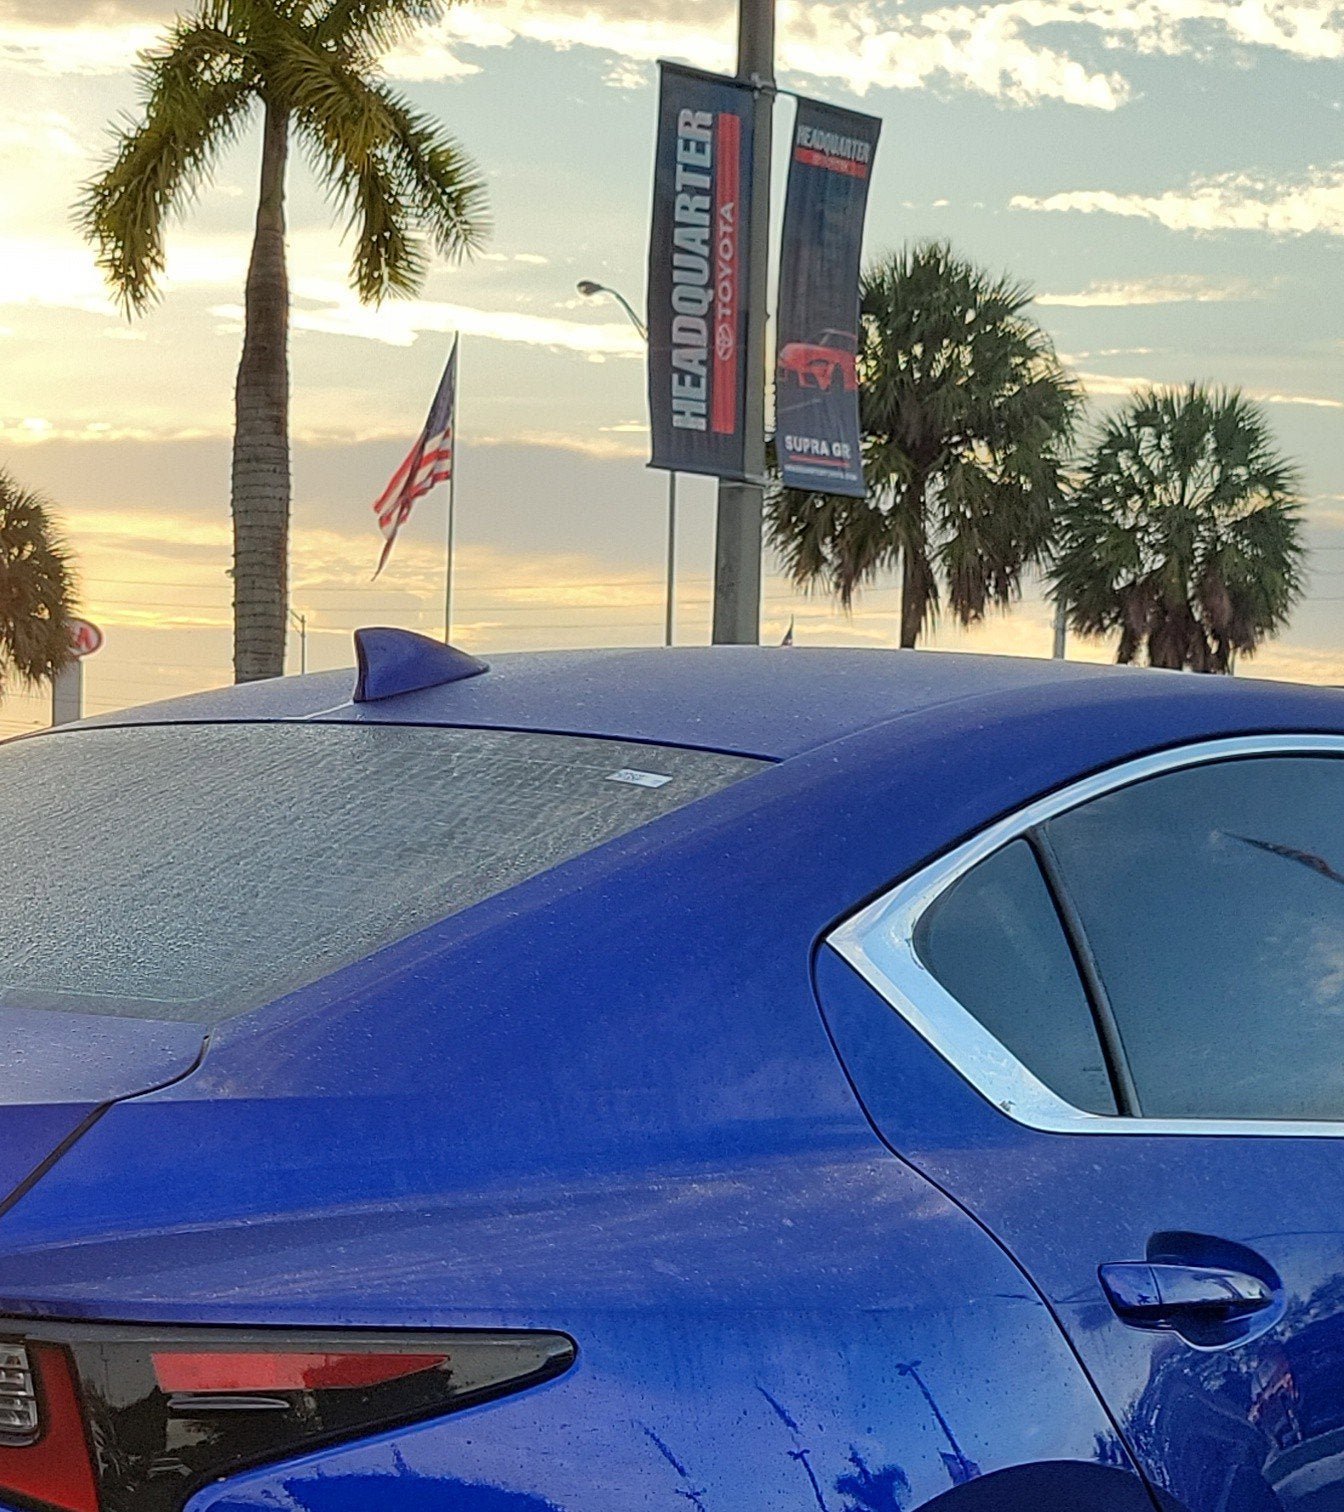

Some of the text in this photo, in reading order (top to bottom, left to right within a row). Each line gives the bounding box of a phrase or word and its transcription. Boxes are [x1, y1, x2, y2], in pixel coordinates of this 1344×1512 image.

[671, 108, 714, 431] HEADQUARTER
[718, 201, 735, 318] TOYOTA
[784, 435, 851, 460] SUPRA GR
